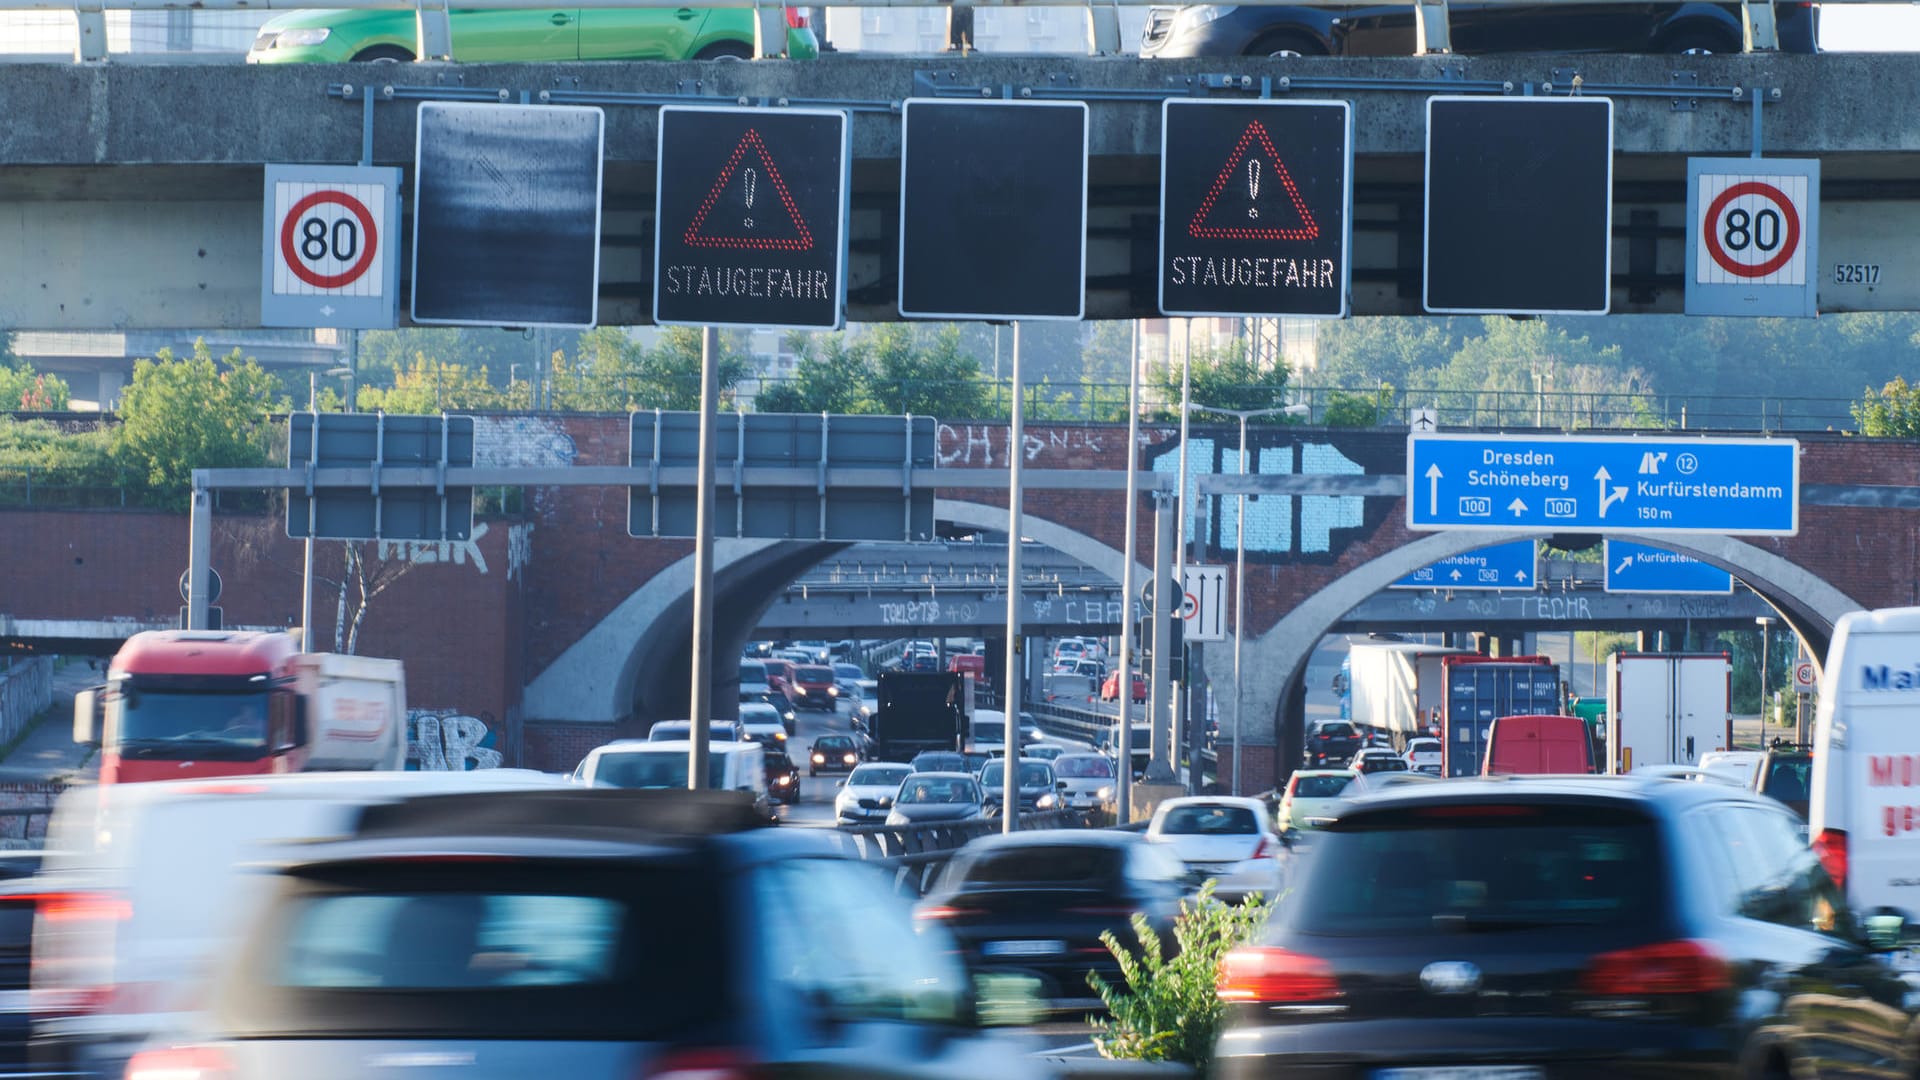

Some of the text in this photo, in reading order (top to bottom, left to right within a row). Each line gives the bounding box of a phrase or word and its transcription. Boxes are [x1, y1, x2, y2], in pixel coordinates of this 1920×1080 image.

[1725, 208, 1780, 251] 80
[302, 217, 356, 261] 80
[1172, 256, 1334, 288] STAUGEFAHR
[1836, 264, 1880, 283] 52517
[667, 265, 828, 299] STAUGEFAHR
[1483, 449, 1554, 465] Dresden
[1679, 457, 1694, 470] 12
[1468, 470, 1569, 490] Schöneberg
[1637, 481, 1783, 499] Kurfürstendamm
[1464, 500, 1486, 513] 100
[1551, 501, 1571, 514] 100
[1638, 507, 1673, 520] 150 m
